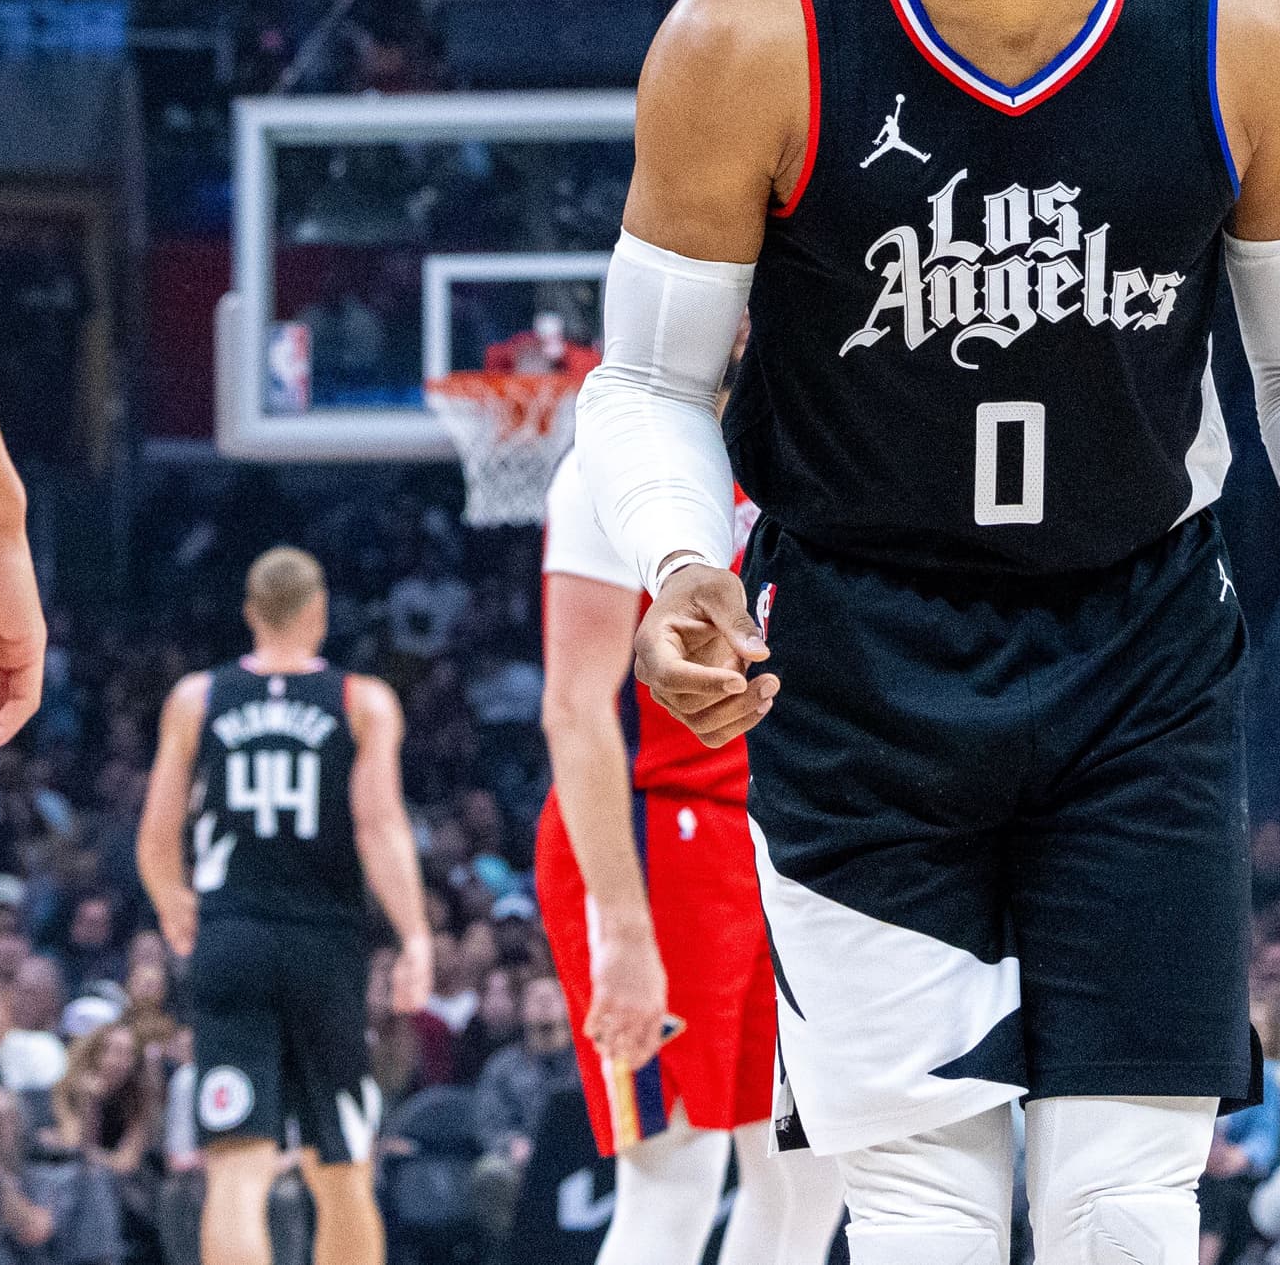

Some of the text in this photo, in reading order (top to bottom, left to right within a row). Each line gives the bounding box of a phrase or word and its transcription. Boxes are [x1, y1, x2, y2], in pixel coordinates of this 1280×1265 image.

[922, 168, 1082, 269] Los
[838, 222, 1187, 371] Angeles
[974, 401, 1046, 526] 0
[224, 748, 320, 839] 44
